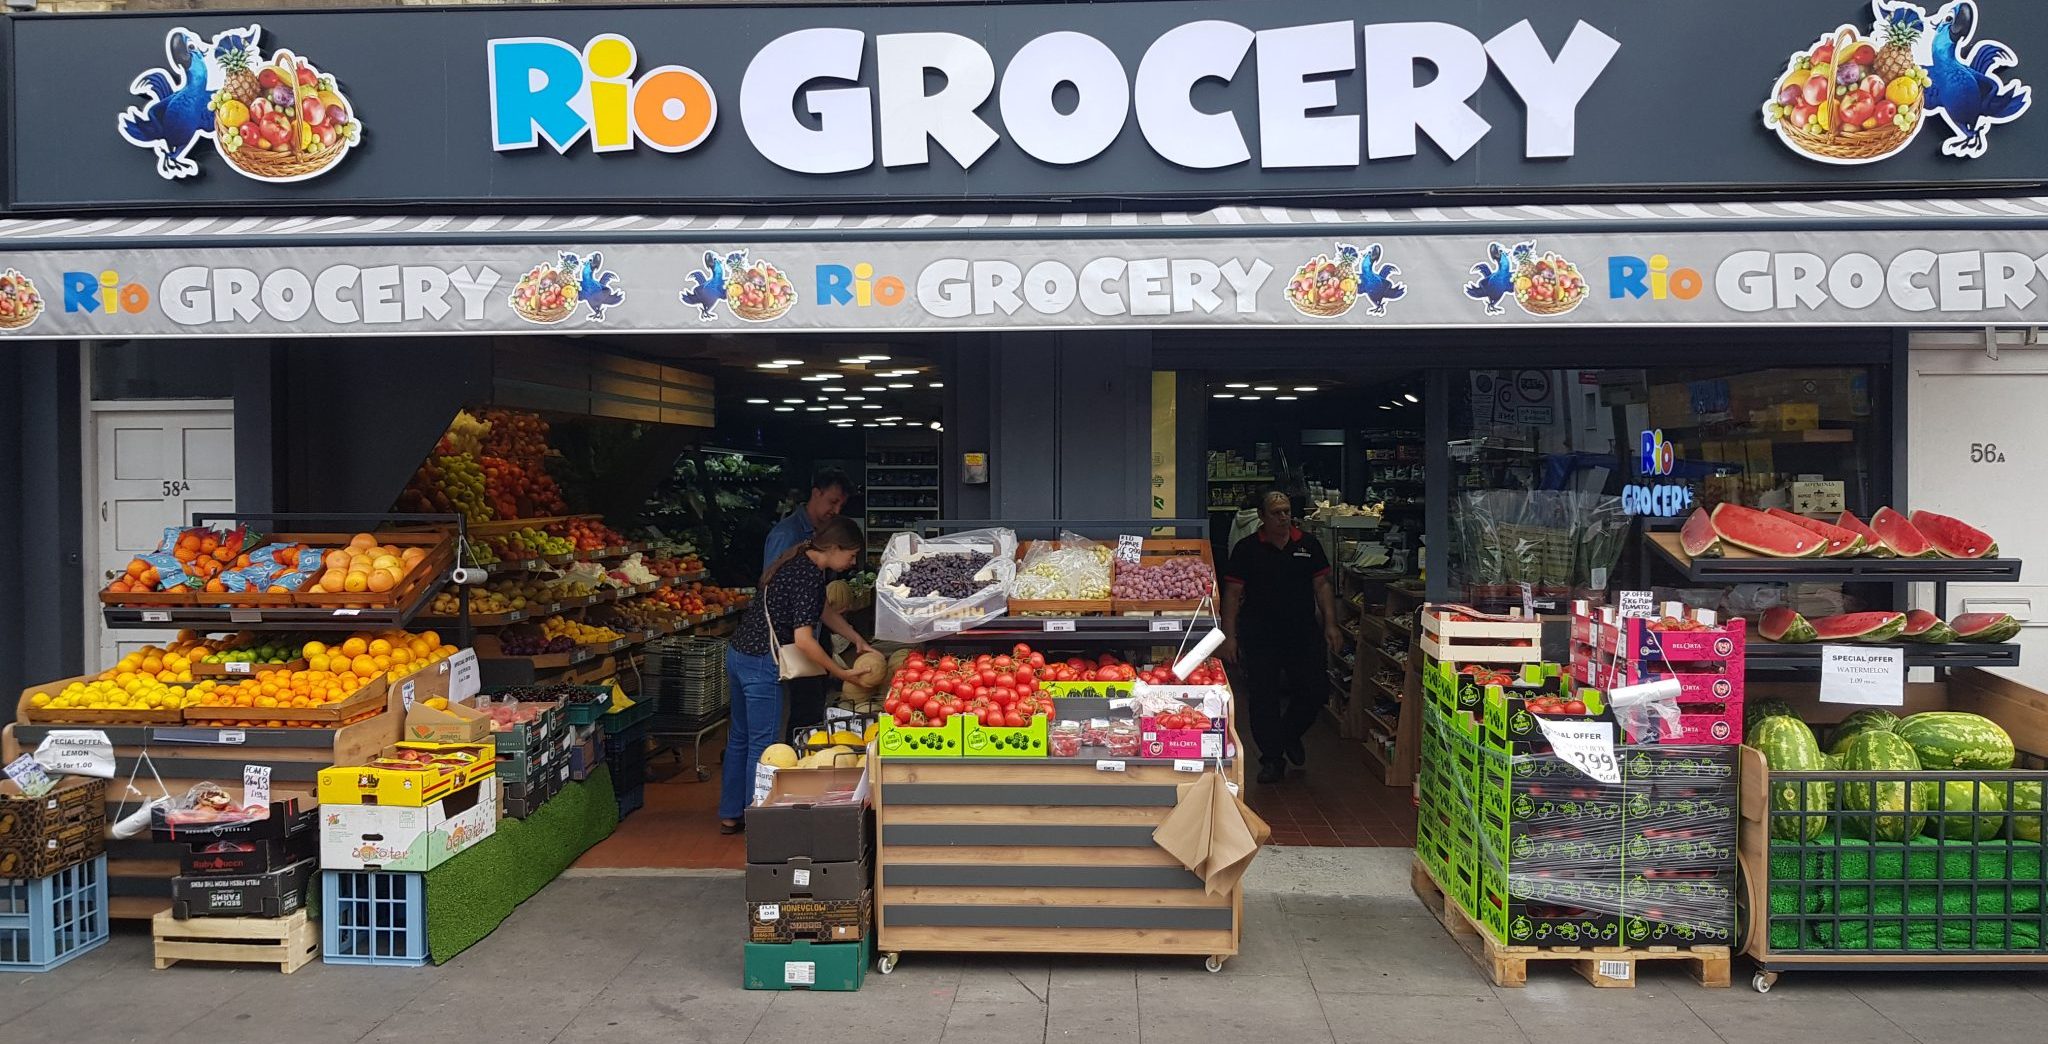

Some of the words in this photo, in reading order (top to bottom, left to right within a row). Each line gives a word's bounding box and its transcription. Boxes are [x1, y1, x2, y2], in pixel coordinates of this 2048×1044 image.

[487, 33, 718, 155] Rio
[740, 19, 1622, 174] GROCERY
[815, 263, 906, 308] Rio
[916, 257, 1274, 318] GROCERY
[1608, 254, 1703, 301] Rio
[63, 270, 150, 315] Rio
[159, 264, 501, 326] GROCERY
[1641, 429, 1674, 476] Rio
[1970, 443, 2006, 463] 56A
[163, 481, 190, 497] 58A
[1621, 484, 1694, 517] GROCERY
[1832, 654, 1867, 662] SPECIAL
[1837, 666, 1889, 674] WATERMELON
[1573, 732, 1602, 740] OFFER
[211, 893, 240, 901] FARMS
[781, 904, 826, 912] HONEYGLOW
